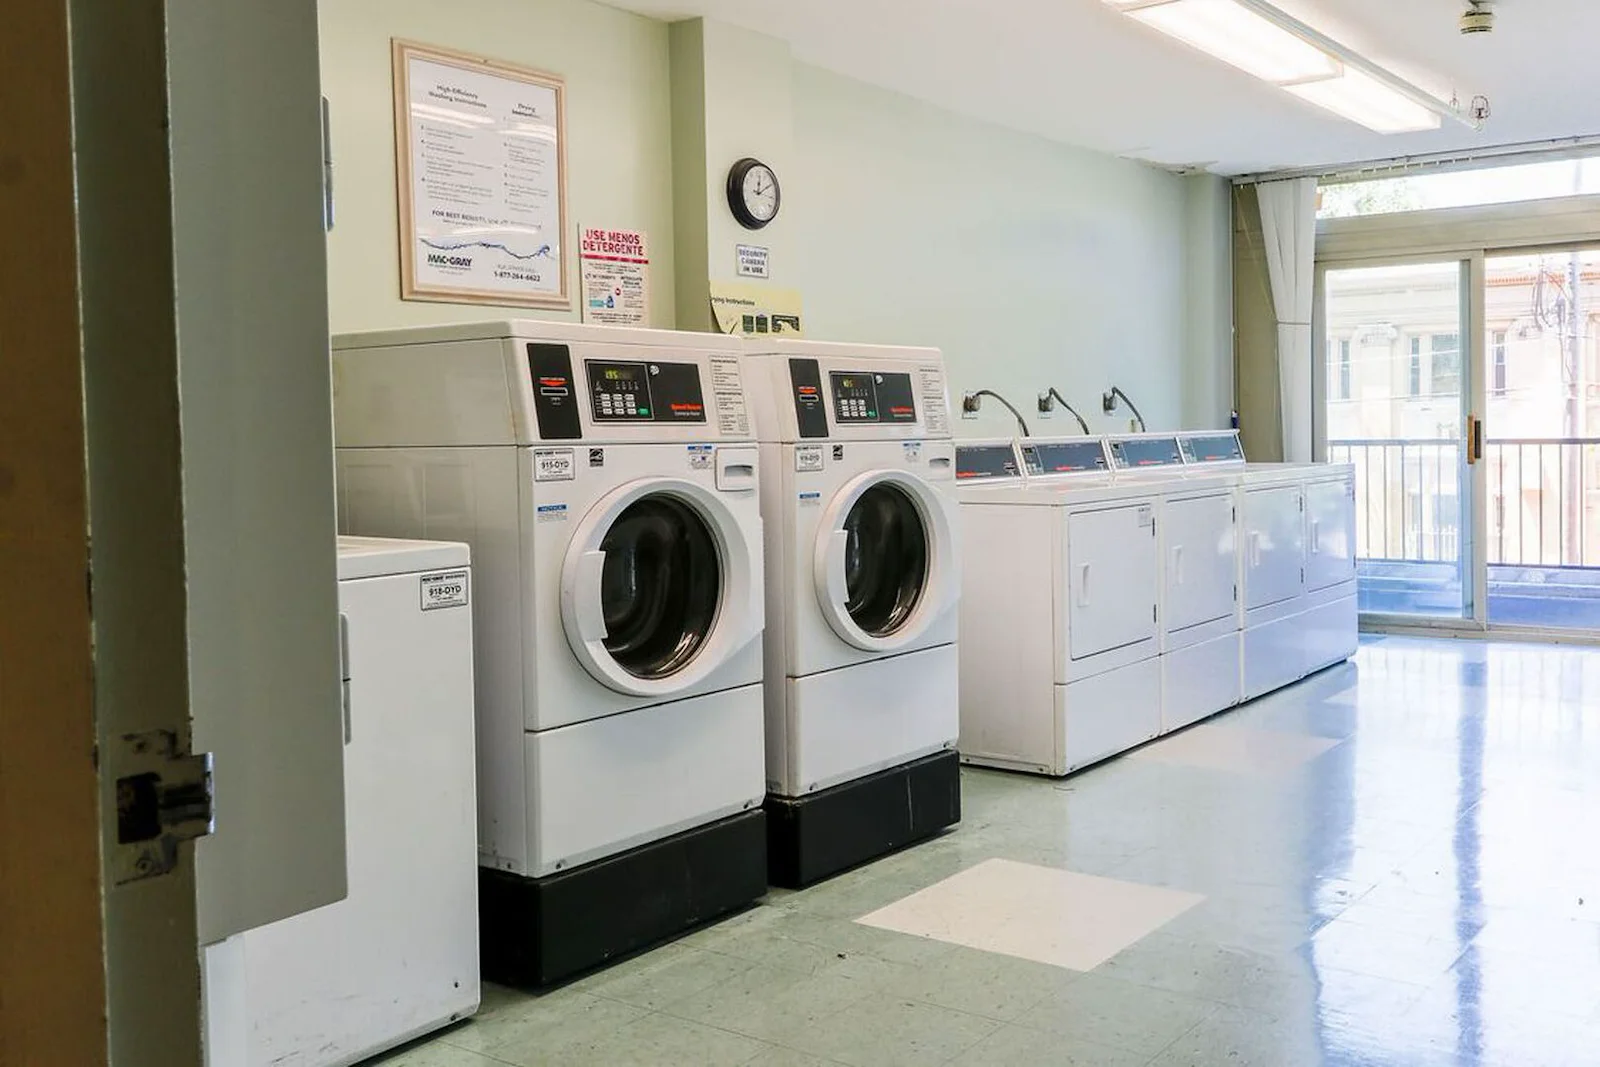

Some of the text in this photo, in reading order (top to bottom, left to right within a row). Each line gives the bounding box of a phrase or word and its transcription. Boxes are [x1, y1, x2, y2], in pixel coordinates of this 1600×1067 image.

[446, 211, 461, 219] BEST
[586, 229, 640, 245] USE MENOS
[583, 240, 643, 256] DETERGENTE
